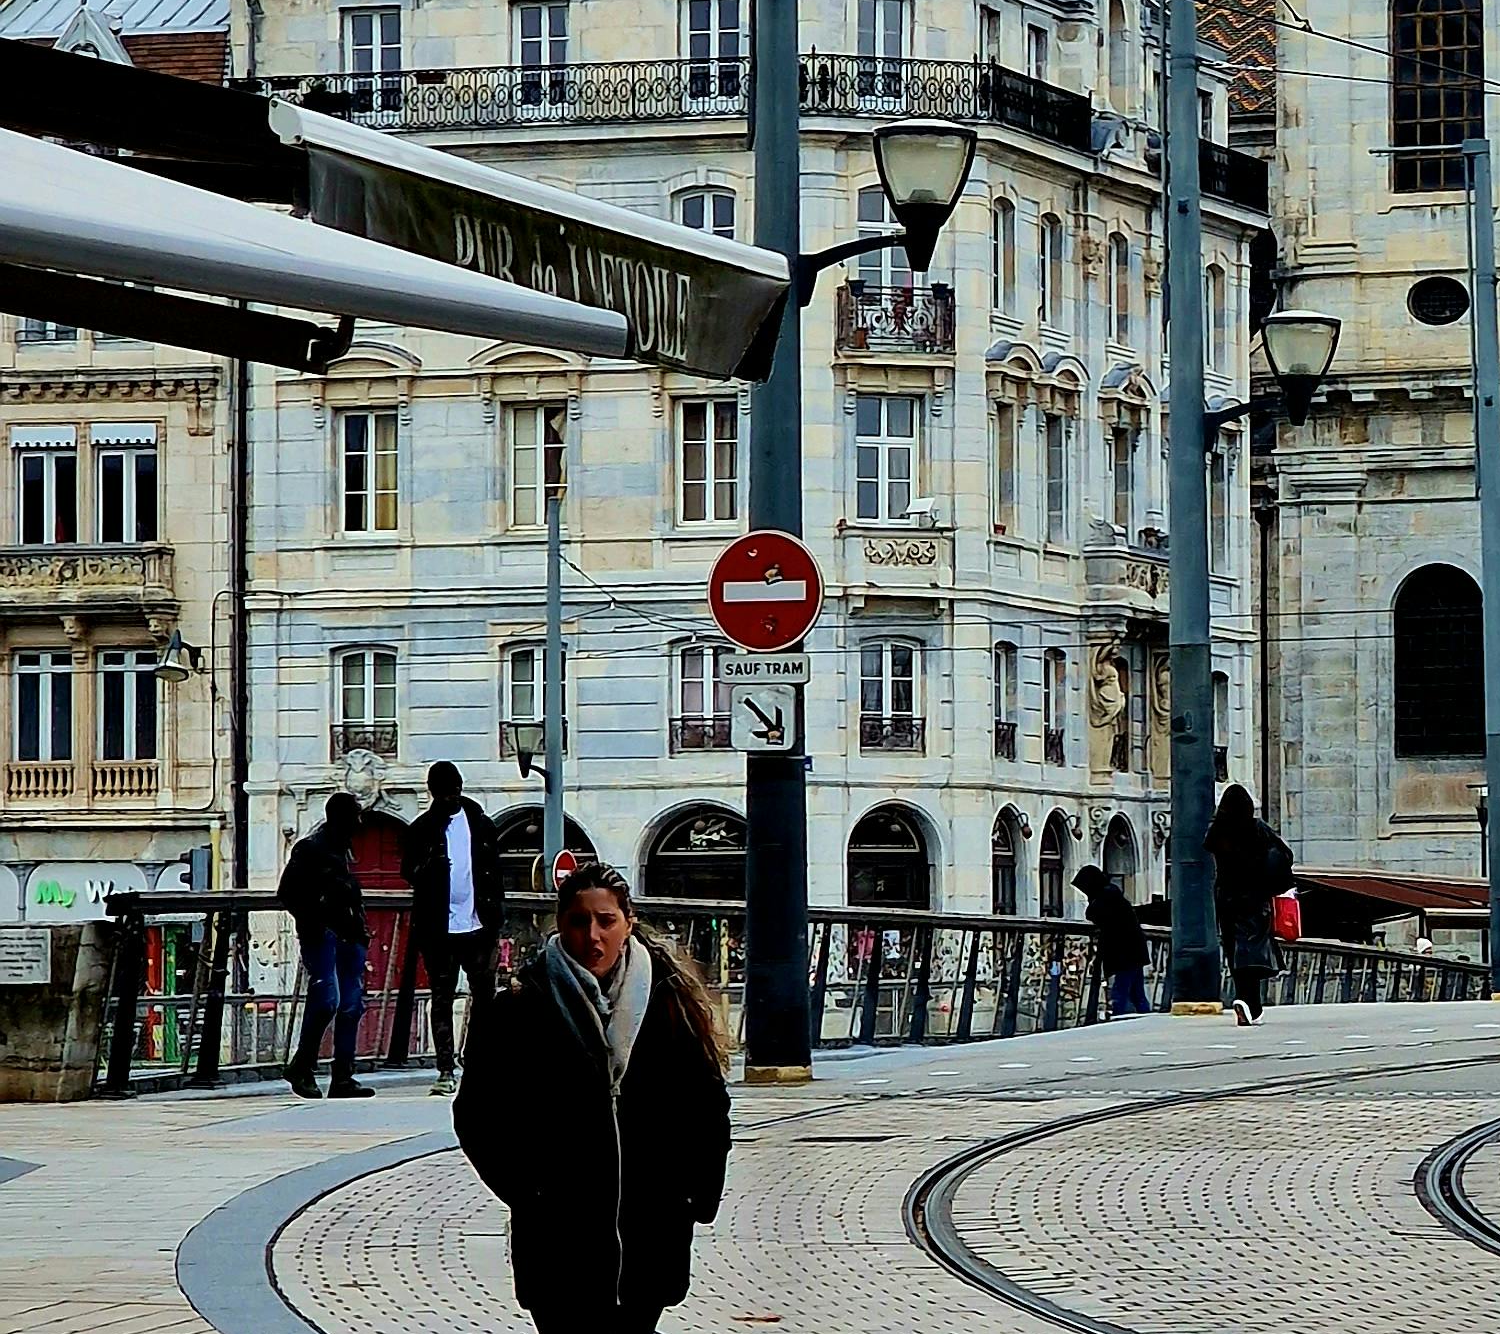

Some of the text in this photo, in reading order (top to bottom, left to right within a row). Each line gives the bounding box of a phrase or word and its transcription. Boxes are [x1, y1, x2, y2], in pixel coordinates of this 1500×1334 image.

[724, 661, 804, 676] SAUF TRAM
[36, 879, 77, 909] My
